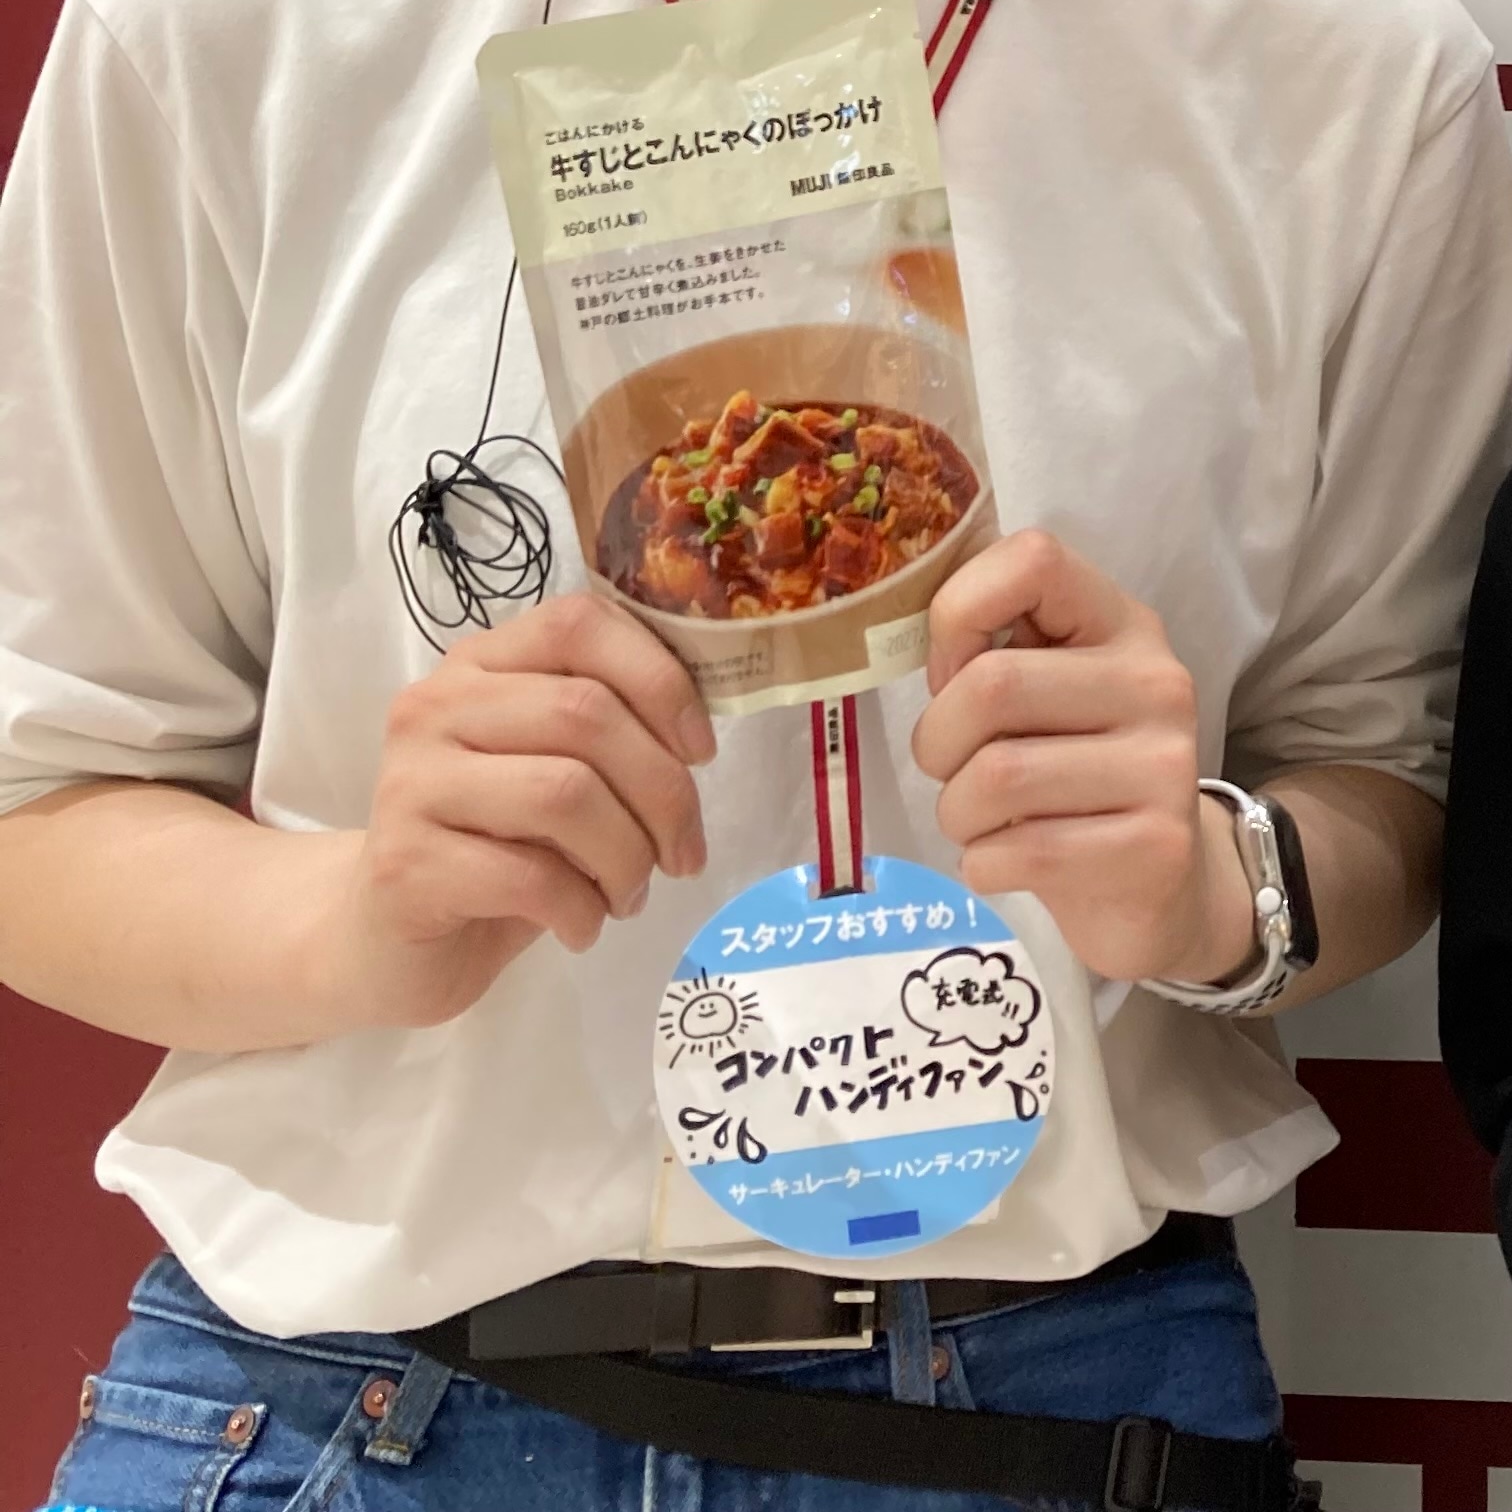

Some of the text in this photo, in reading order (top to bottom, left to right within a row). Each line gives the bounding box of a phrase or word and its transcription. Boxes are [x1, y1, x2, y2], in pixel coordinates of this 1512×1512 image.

[545, 117, 645, 146] ごはんにかける
[551, 95, 882, 183] 牛すじとこんにゃくのぼっかけ
[555, 179, 634, 203] Bokkake
[790, 173, 833, 197] MUJI
[720, 897, 979, 957] スタッフおすすめ！
[715, 1025, 895, 1093] コンパクト
[794, 1054, 1005, 1118] ハンディファン
[728, 1145, 1021, 1206] サーキュレーター・ハンディファン
